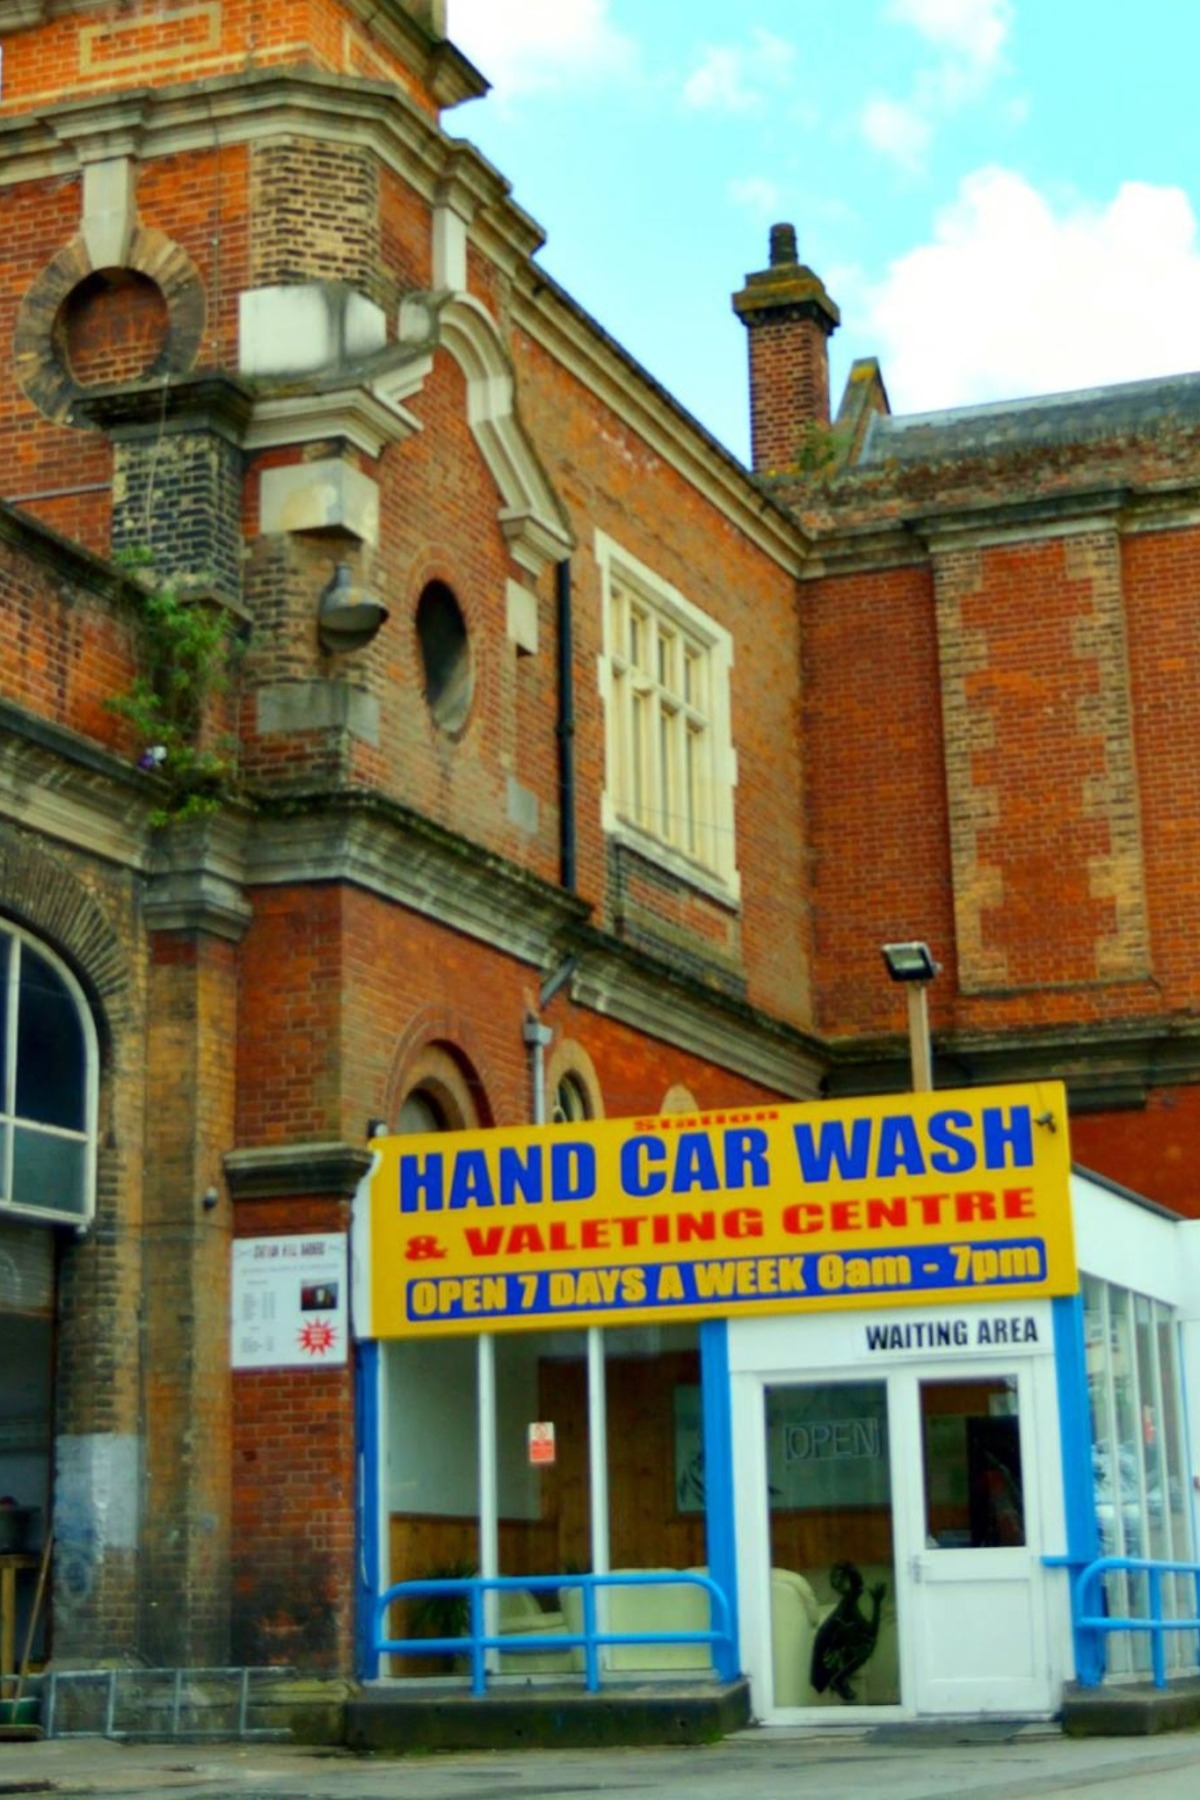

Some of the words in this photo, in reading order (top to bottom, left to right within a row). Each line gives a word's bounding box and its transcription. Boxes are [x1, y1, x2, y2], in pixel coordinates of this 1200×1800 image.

[400, 1142, 597, 1213] HAND
[620, 1128, 771, 1197] CAR
[793, 1105, 1034, 1184] WASH
[405, 1234, 446, 1261] &
[464, 1208, 764, 1257] VALETING
[782, 1187, 1036, 1236] CENTRE
[412, 1277, 507, 1316] OPEN
[517, 1274, 540, 1309] 7
[550, 1267, 647, 1306] DAYS
[657, 1265, 685, 1300] A
[693, 1258, 806, 1298] WEEK
[949, 1245, 1041, 1283] 7pm
[865, 1321, 969, 1351] WAITING
[977, 1317, 1039, 1345] AREA
[788, 1421, 878, 1459] OPEN
